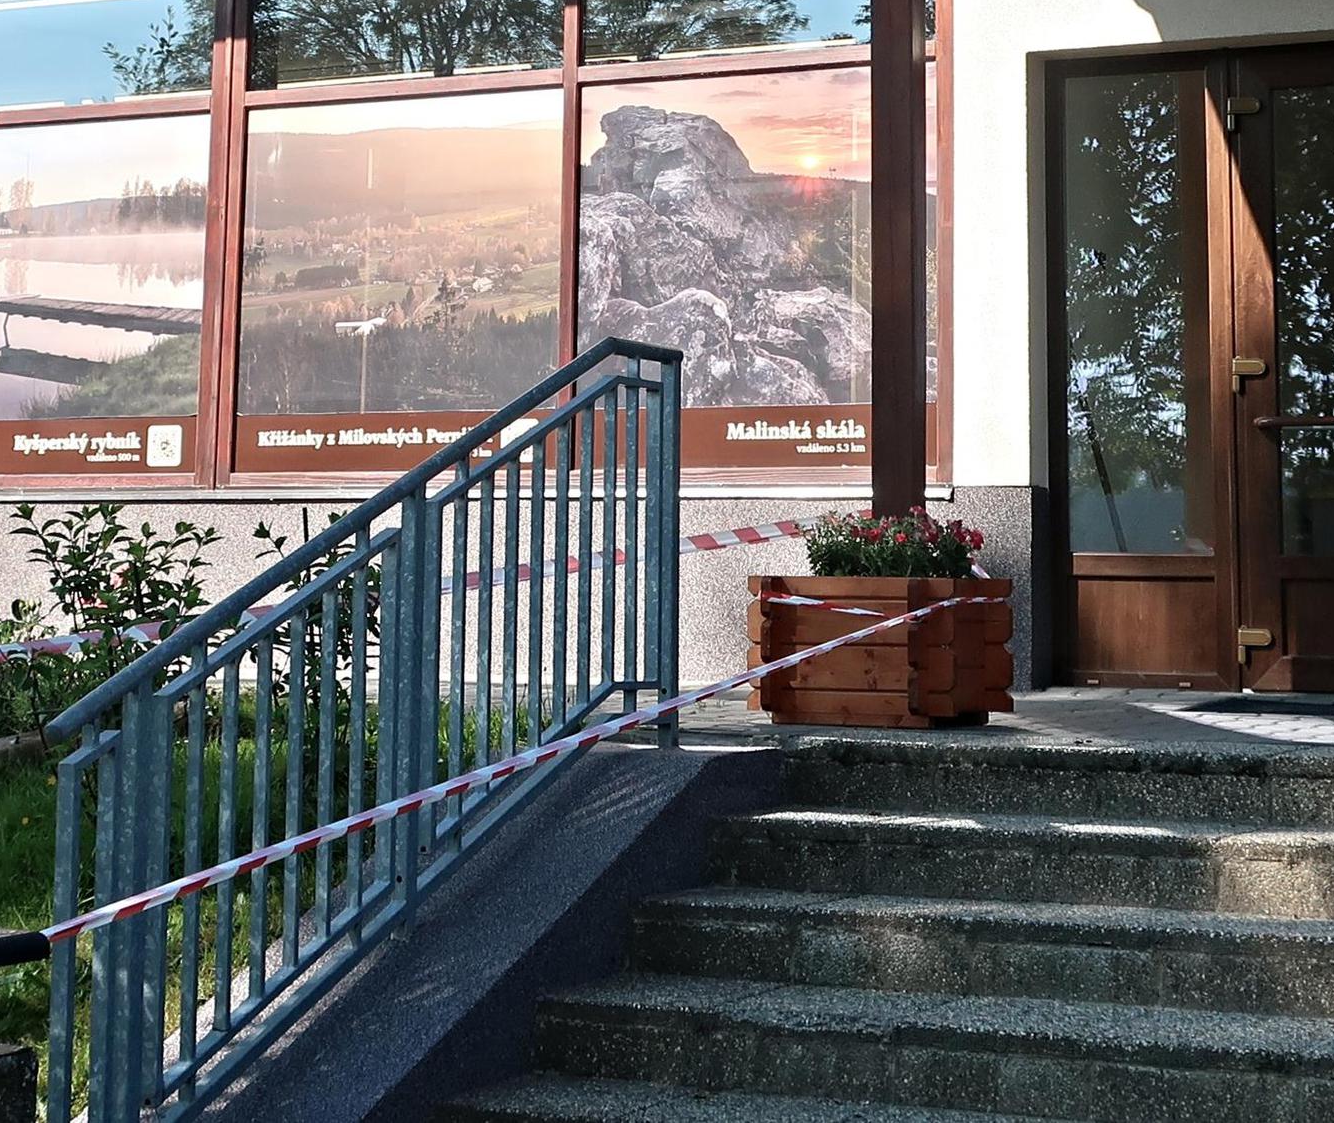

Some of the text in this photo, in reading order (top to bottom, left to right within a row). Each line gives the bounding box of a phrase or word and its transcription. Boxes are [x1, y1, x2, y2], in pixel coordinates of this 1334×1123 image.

[257, 430, 323, 449] Křižánky
[326, 433, 335, 446] z
[338, 428, 423, 449] Milovských
[726, 419, 866, 440] Malinská skála
[13, 432, 141, 455] Kyšperský rybník
[796, 442, 866, 454] vzdáleno 5.3 km
